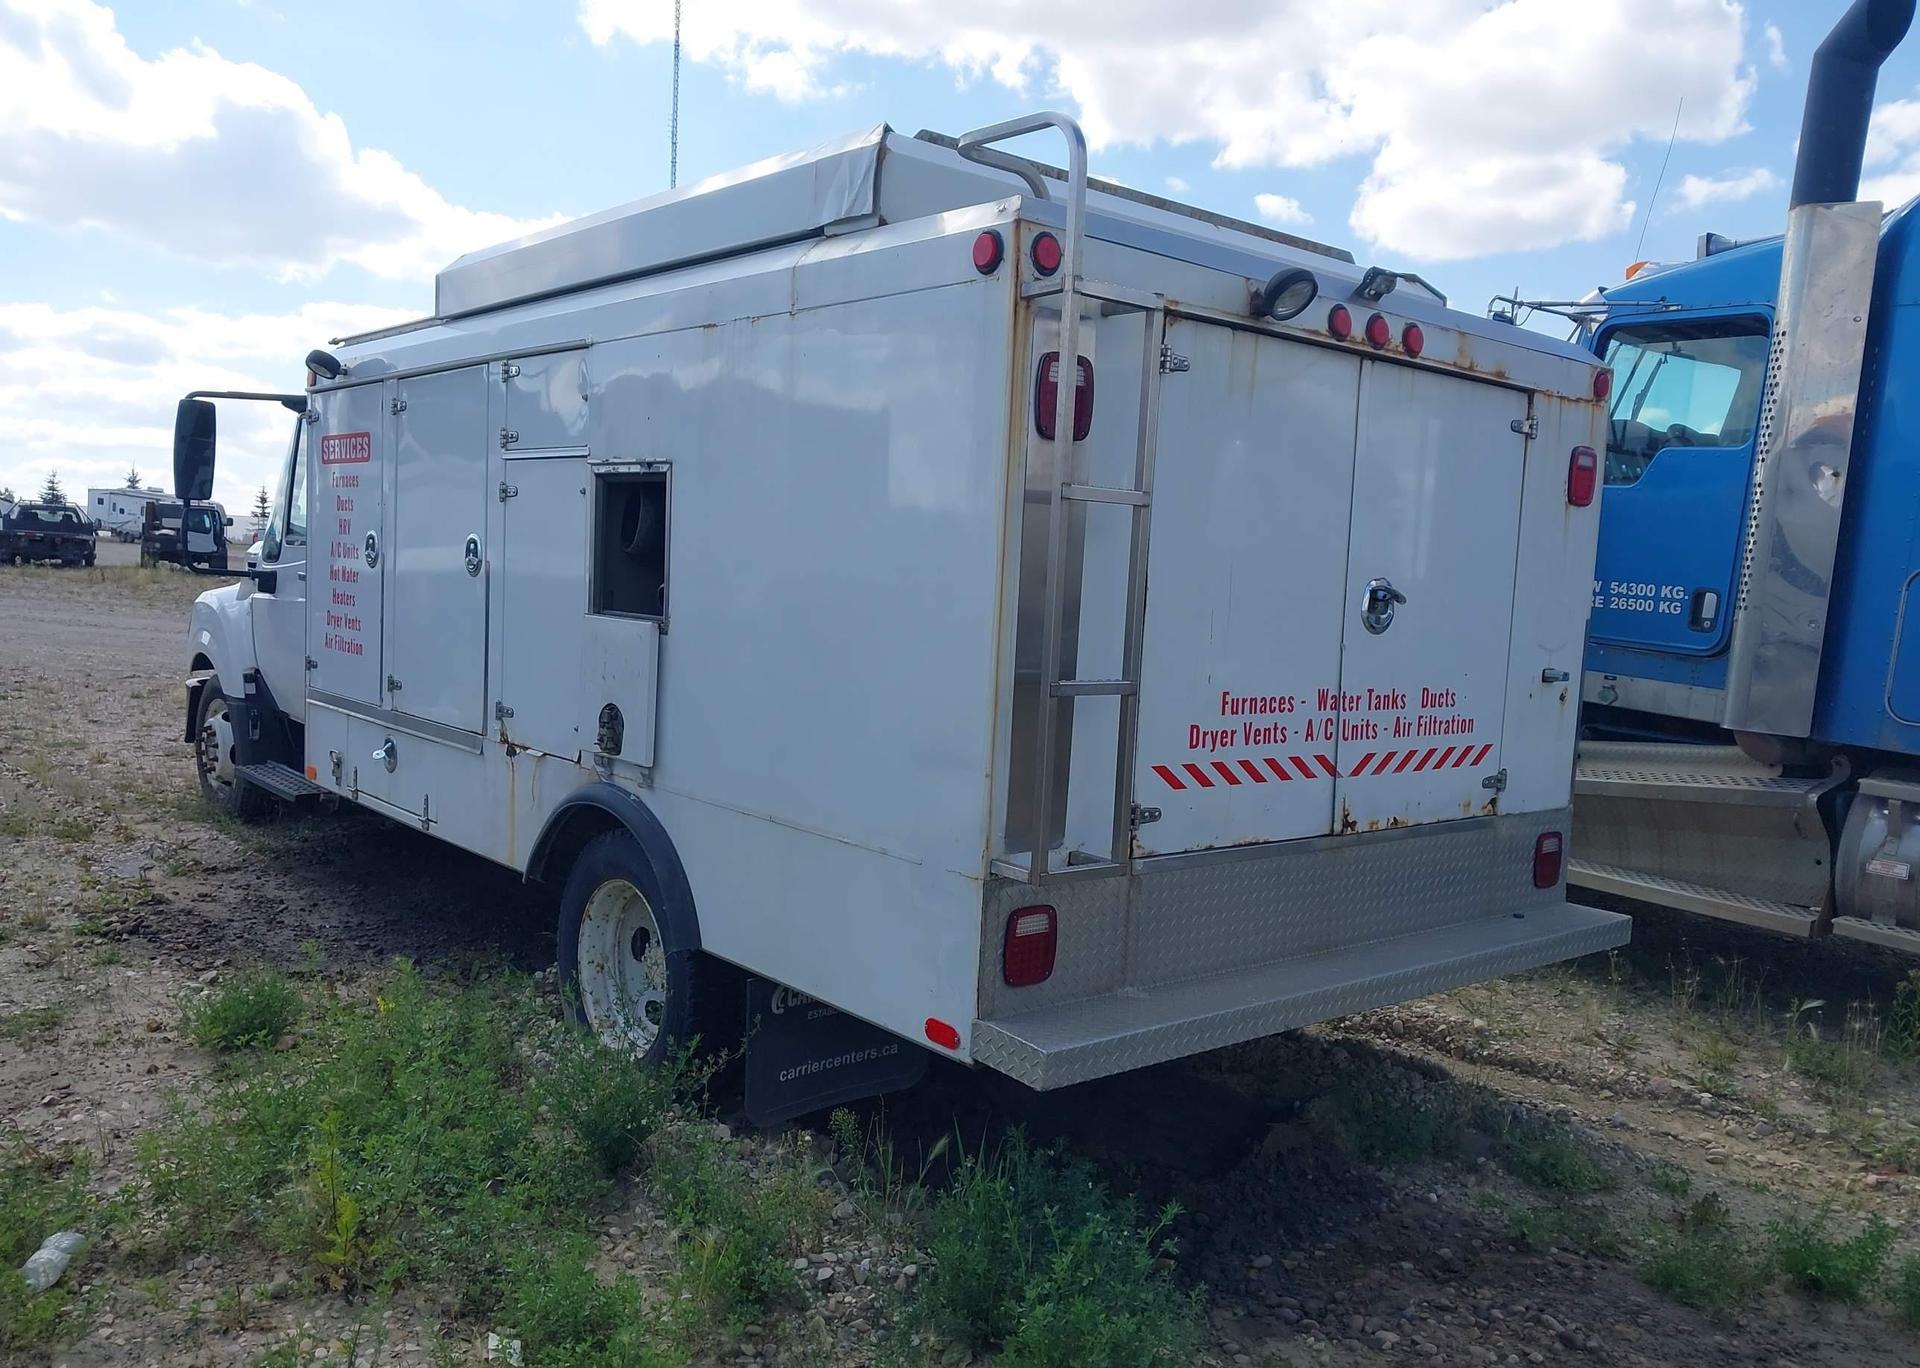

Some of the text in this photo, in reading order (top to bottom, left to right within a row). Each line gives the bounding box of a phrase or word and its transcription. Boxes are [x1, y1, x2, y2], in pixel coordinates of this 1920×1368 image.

[323, 436, 369, 460] SERVICES
[332, 471, 359, 488] Furnaces
[336, 495, 354, 512] Ducts
[338, 518, 352, 535] HRV
[330, 541, 359, 560] A/C Units
[329, 564, 359, 583] Hot Water
[332, 588, 356, 607] Heaters
[1609, 582, 1656, 597] 54300
[1660, 585, 1689, 600] KG.
[1609, 597, 1655, 612] 26500
[1658, 601, 1682, 614] KG
[326, 610, 362, 632] Dryer Vents
[325, 632, 364, 656] Air Filtration
[1220, 691, 1295, 716] Furnaces
[1316, 687, 1362, 713] Water
[1366, 688, 1407, 711] Tanks
[1420, 687, 1457, 709] Ducts
[1188, 723, 1237, 752] Dryer
[1243, 721, 1288, 746] Vents
[1304, 717, 1334, 743] A/C
[1341, 715, 1378, 742] Units
[1393, 715, 1413, 738] Air
[1416, 715, 1475, 737] Filtration
[778, 1042, 899, 1082] carriercenters.ca
